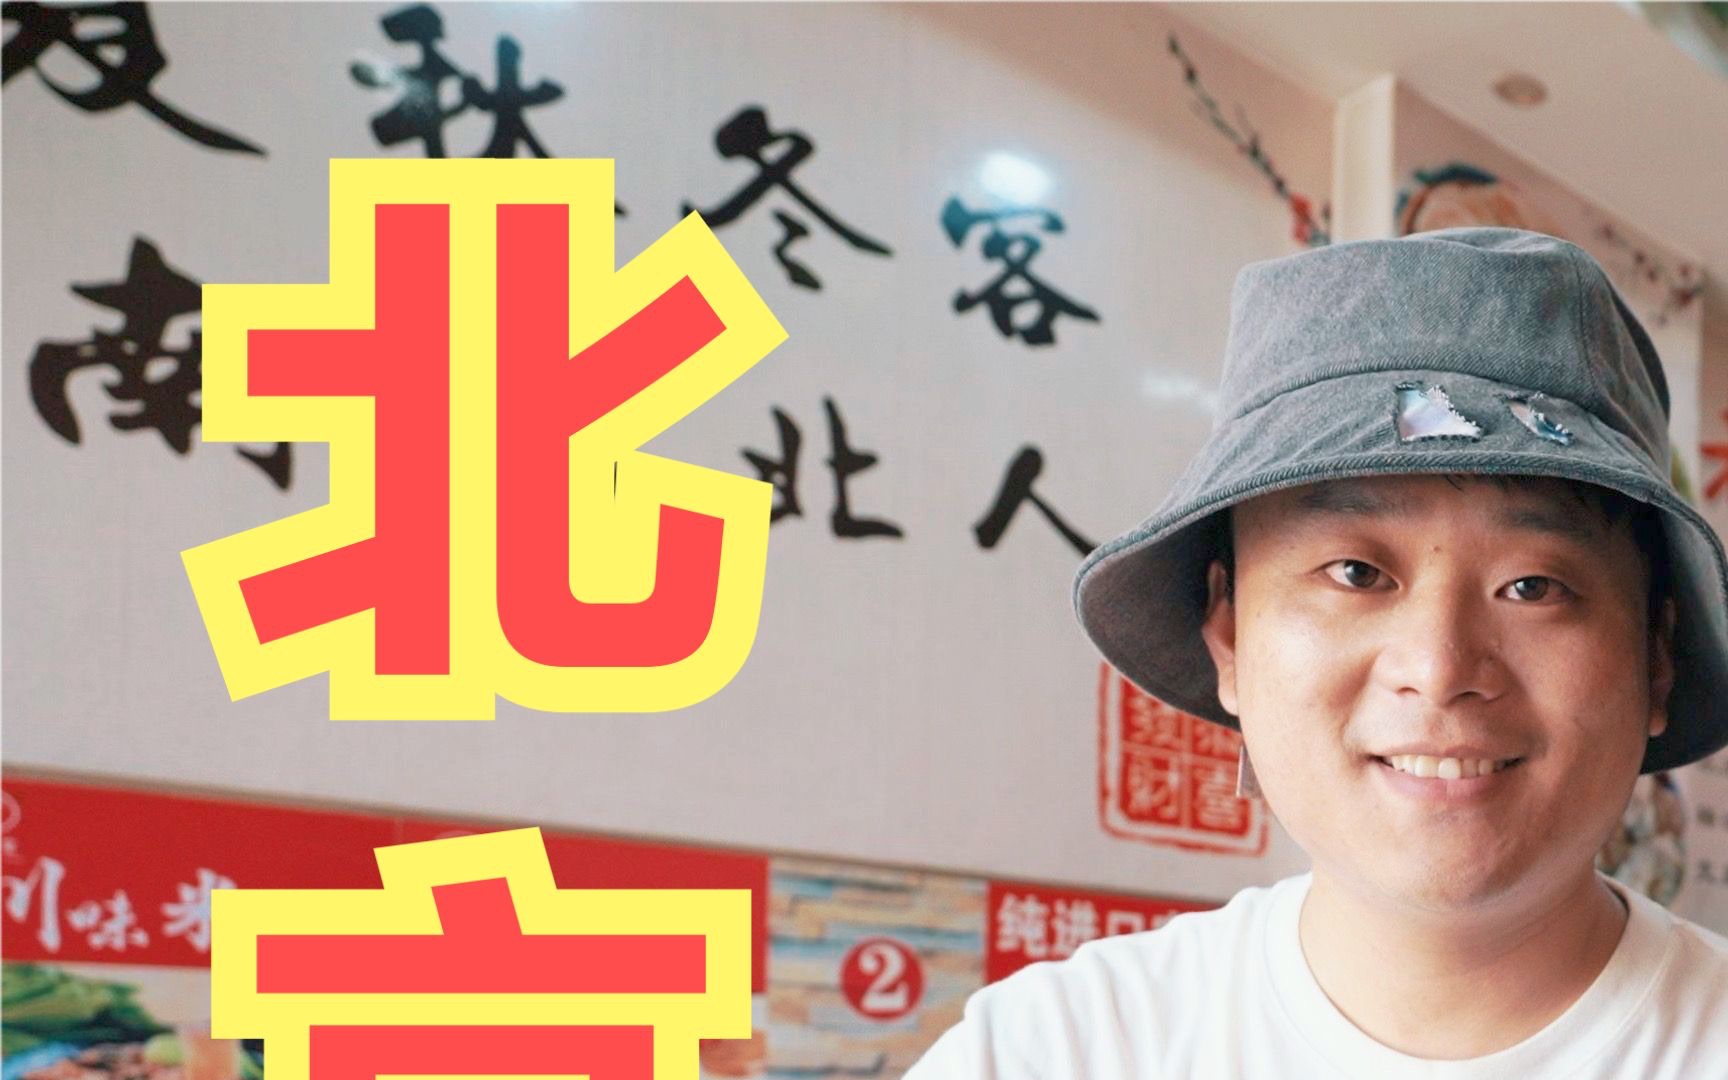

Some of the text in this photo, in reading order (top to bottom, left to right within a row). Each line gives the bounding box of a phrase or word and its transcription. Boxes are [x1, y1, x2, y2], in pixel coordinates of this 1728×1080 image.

[997, 893, 1179, 958] 纯进口
[858, 942, 910, 1014] 2
